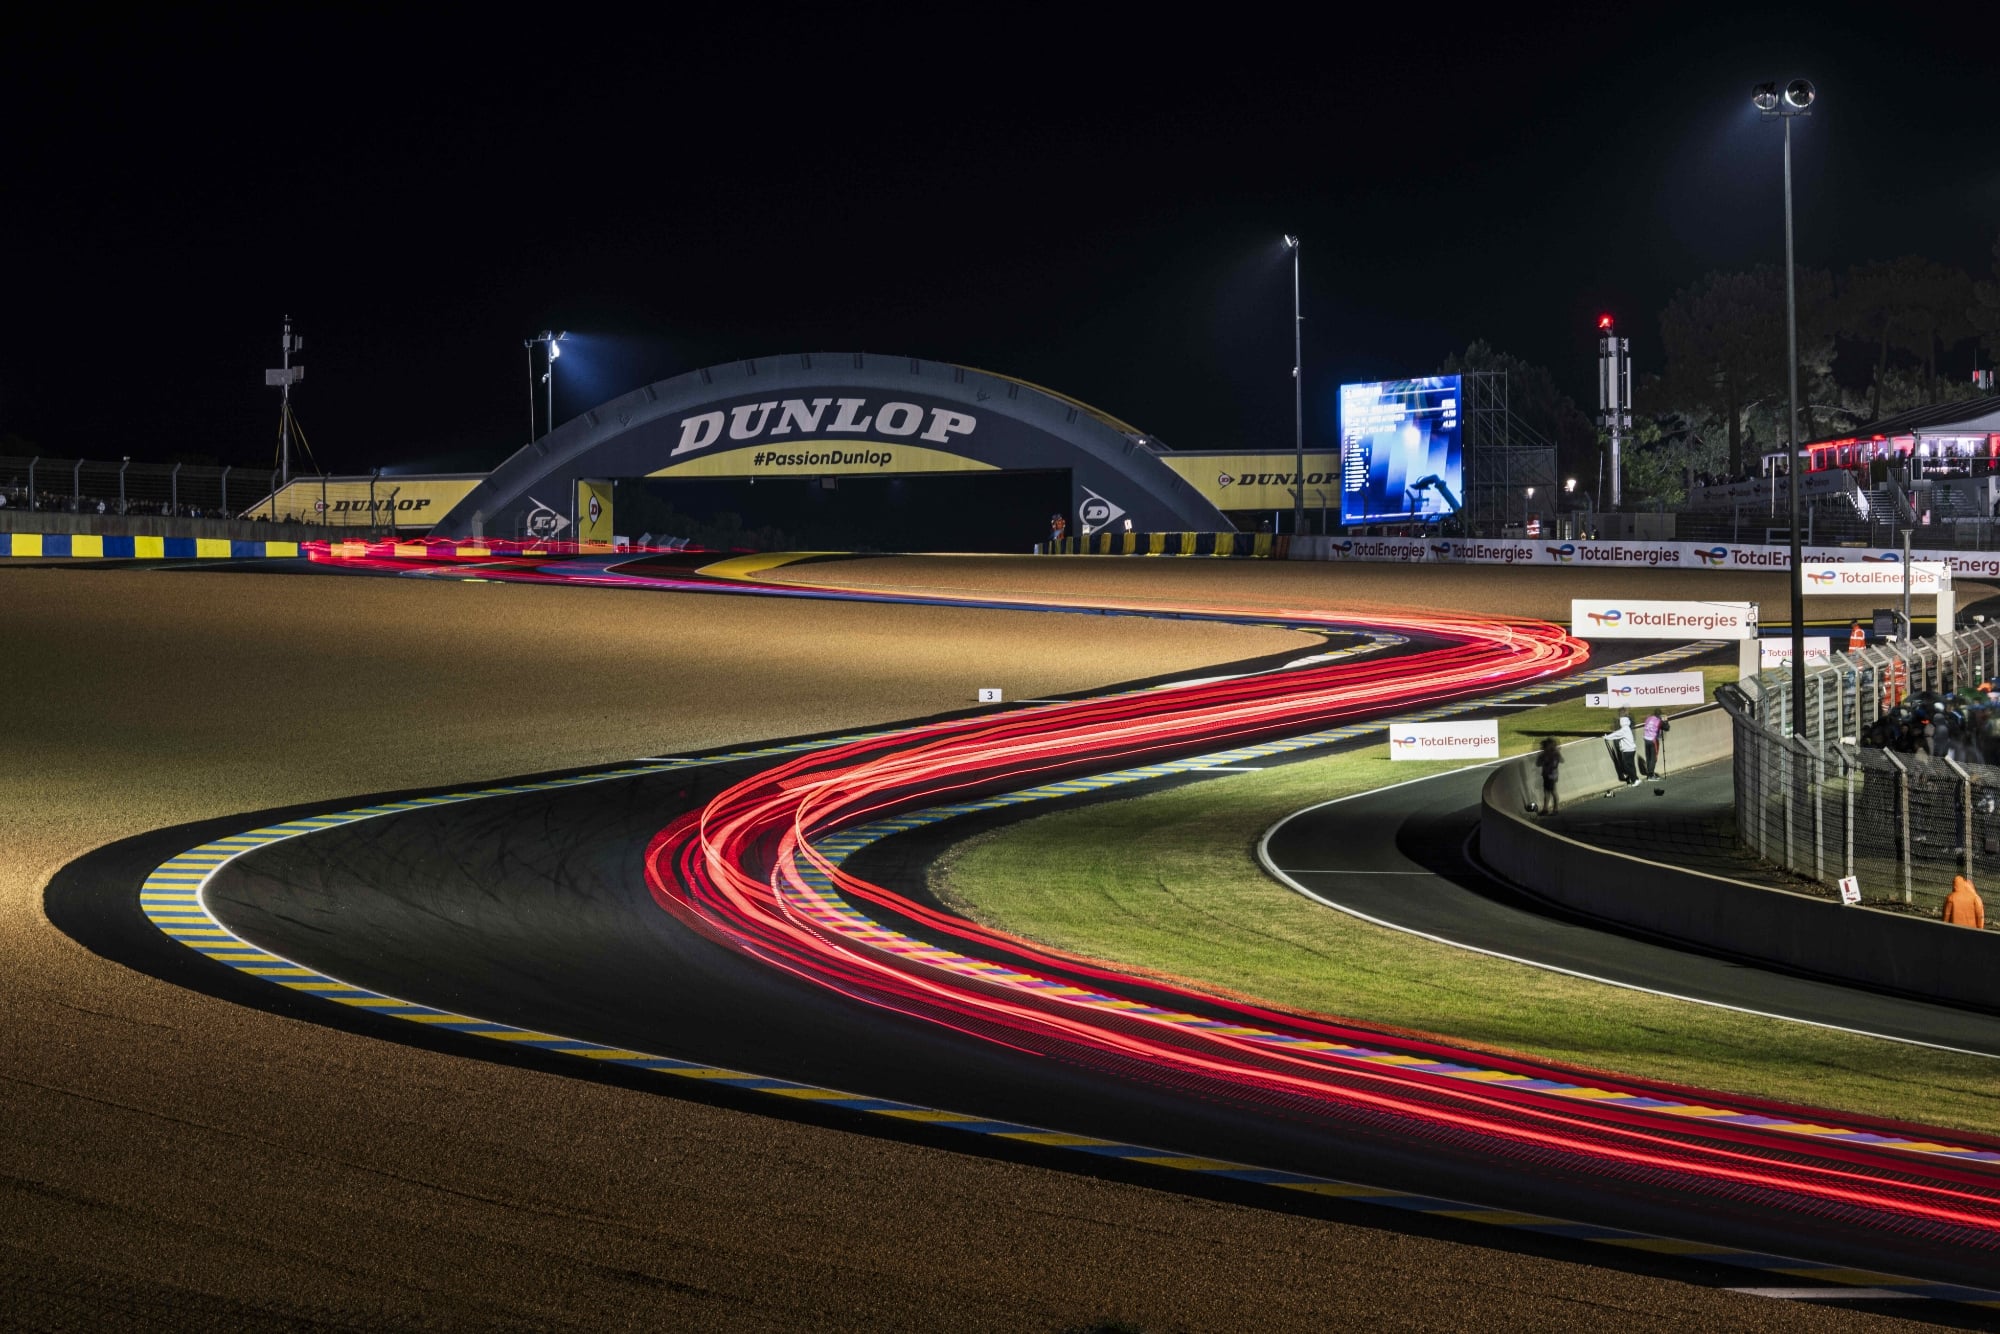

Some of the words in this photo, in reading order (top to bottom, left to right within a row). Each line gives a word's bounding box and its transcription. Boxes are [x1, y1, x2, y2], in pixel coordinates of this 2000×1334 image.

[670, 398, 977, 457] DUNLOP
[753, 450, 892, 467] #PassionDunlop
[1238, 473, 1341, 485] DUNLOP
[332, 499, 431, 512] DUNLOP
[1086, 506, 1109, 520] D
[1353, 542, 1425, 560] TotalEnergies
[1452, 544, 1533, 562] TotalEnergies
[1578, 546, 1680, 565] TotalEnergies
[1731, 550, 1846, 566] TotalEnries
[1625, 612, 1738, 630] TotalEnergies
[1768, 648, 1827, 658] TotalErgies
[987, 691, 993, 700] 3
[1634, 684, 1700, 695] TotalEnergies
[1593, 696, 1600, 705] 3
[1419, 734, 1496, 747] TotalEnergies
